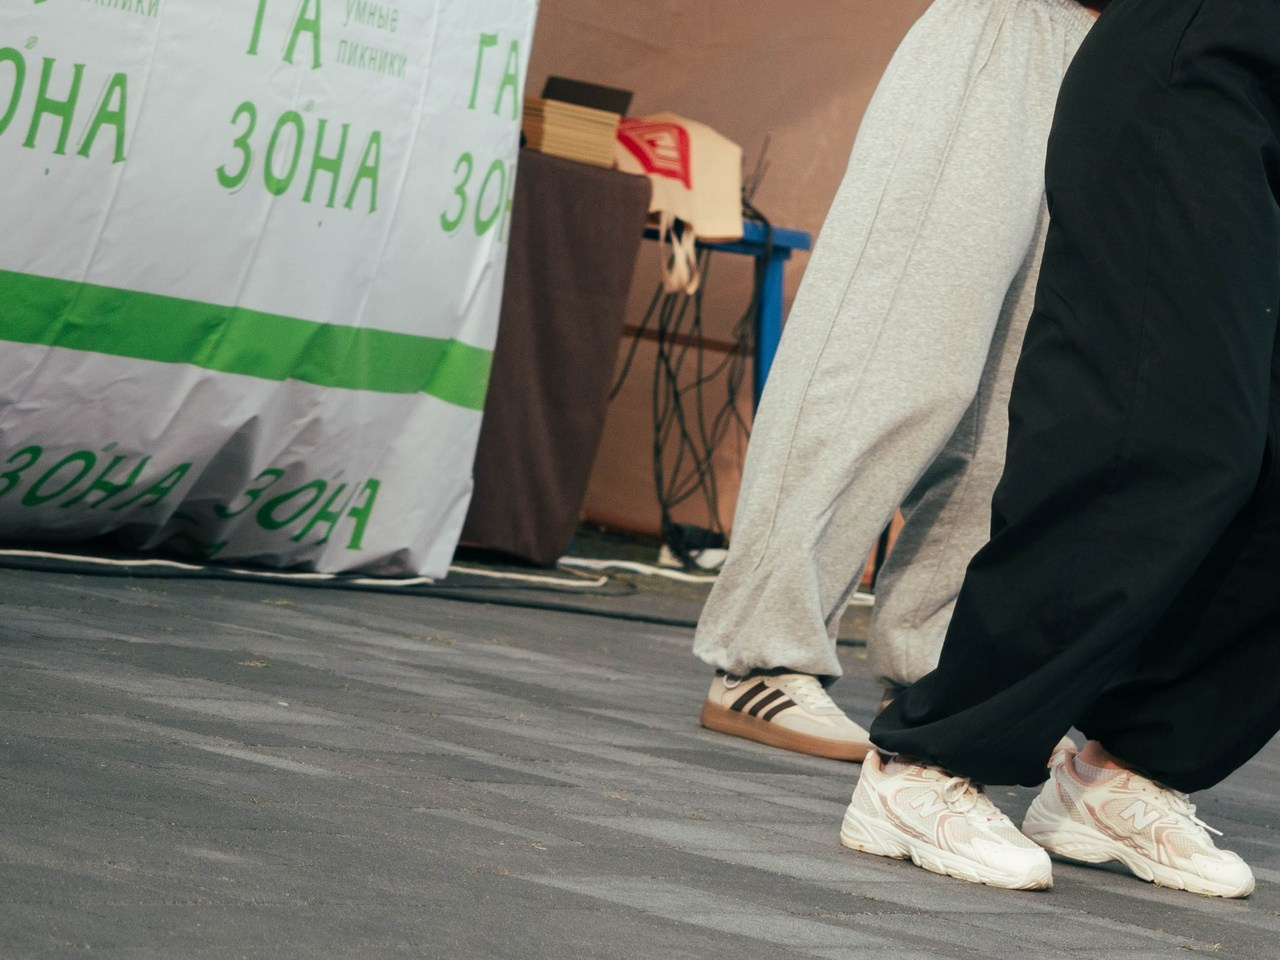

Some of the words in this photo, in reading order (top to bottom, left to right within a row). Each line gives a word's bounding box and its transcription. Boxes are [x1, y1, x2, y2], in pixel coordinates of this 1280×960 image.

[336, 39, 407, 78] пикники
[467, 33, 519, 120] ГА
[215, 101, 382, 215] ЗОНА
